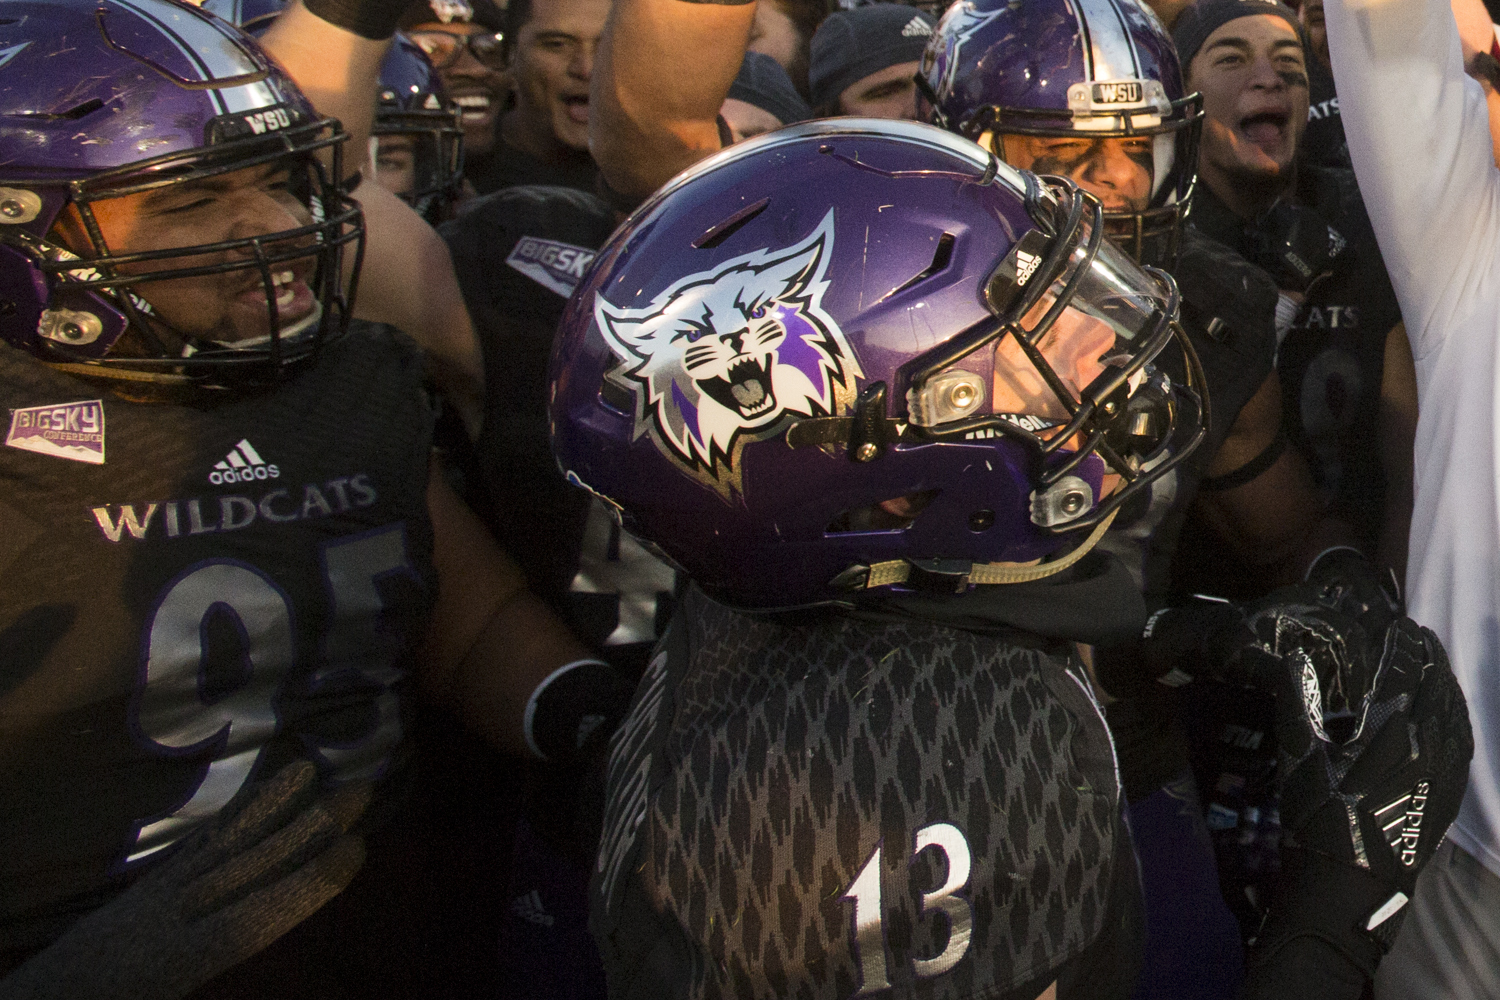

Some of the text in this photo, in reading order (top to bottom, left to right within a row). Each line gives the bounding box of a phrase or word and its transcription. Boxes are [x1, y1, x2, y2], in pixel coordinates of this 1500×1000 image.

[1099, 83, 1138, 103] WSU
[244, 107, 292, 136] WSU
[1016, 254, 1043, 287] adidas
[43, 428, 103, 443] CONFERENCE
[208, 463, 281, 486] adidas
[91, 474, 379, 543] WILDCATS
[120, 522, 406, 865] 95
[1401, 781, 1429, 867] adidas
[838, 821, 974, 999] 13
